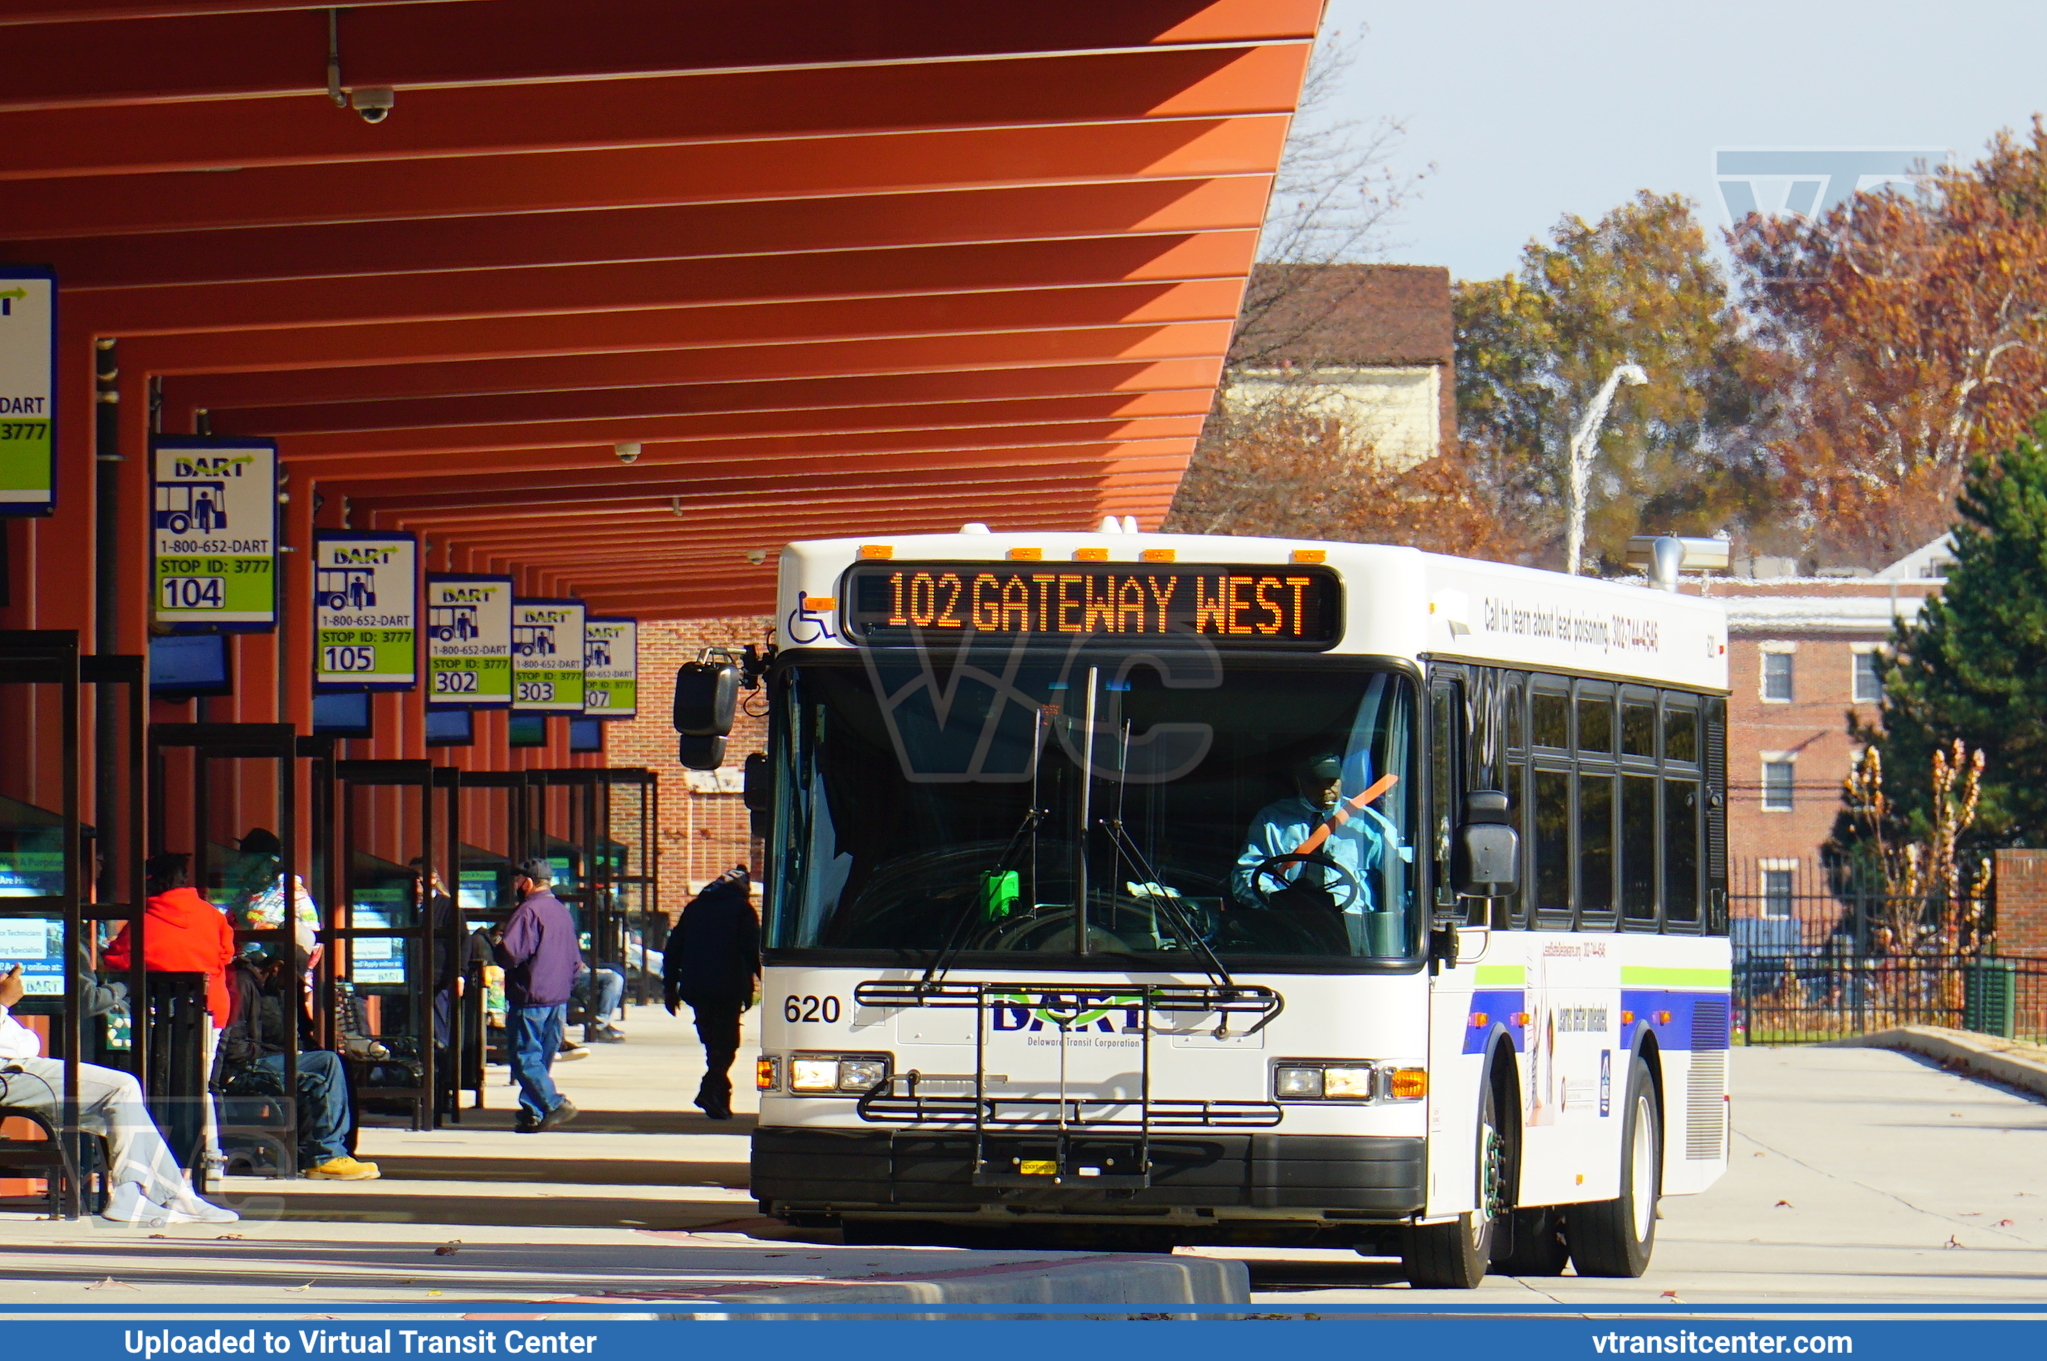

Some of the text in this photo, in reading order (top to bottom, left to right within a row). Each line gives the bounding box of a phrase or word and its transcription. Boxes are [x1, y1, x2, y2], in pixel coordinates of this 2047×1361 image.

[1, 424, 47, 440] 3777
[175, 457, 248, 477] DART
[161, 540, 269, 553] 1-800-652-DART
[334, 548, 395, 564] DART
[161, 560, 270, 573] STOP ID: 3777
[165, 579, 221, 607] 104
[443, 588, 492, 602] DART
[888, 572, 1311, 635] 102 GATEWAY WEST
[322, 615, 410, 627] 1-800-652-DART
[525, 610, 568, 623] DART
[1485, 597, 1499, 632] Call
[1502, 601, 1509, 633] to
[1511, 600, 1531, 635] learn
[1534, 603, 1554, 638] about
[1556, 605, 1571, 642] lead
[322, 632, 411, 643] STOP ID: 3777
[433, 646, 508, 656] 1-800-652-DART
[325, 648, 371, 671] 105
[434, 660, 509, 669] STOP ID: 3777
[516, 660, 581, 669] 1-800-652-DART
[436, 672, 477, 692] 302
[516, 672, 540, 680] STOP
[561, 672, 582, 680] 3777
[518, 683, 553, 701] 303
[586, 690, 608, 706] 07
[785, 994, 840, 1024] 620
[992, 993, 1150, 1032] DART
[1066, 1037, 1092, 1047] Transit
[1094, 1037, 1140, 1049] Corporation
